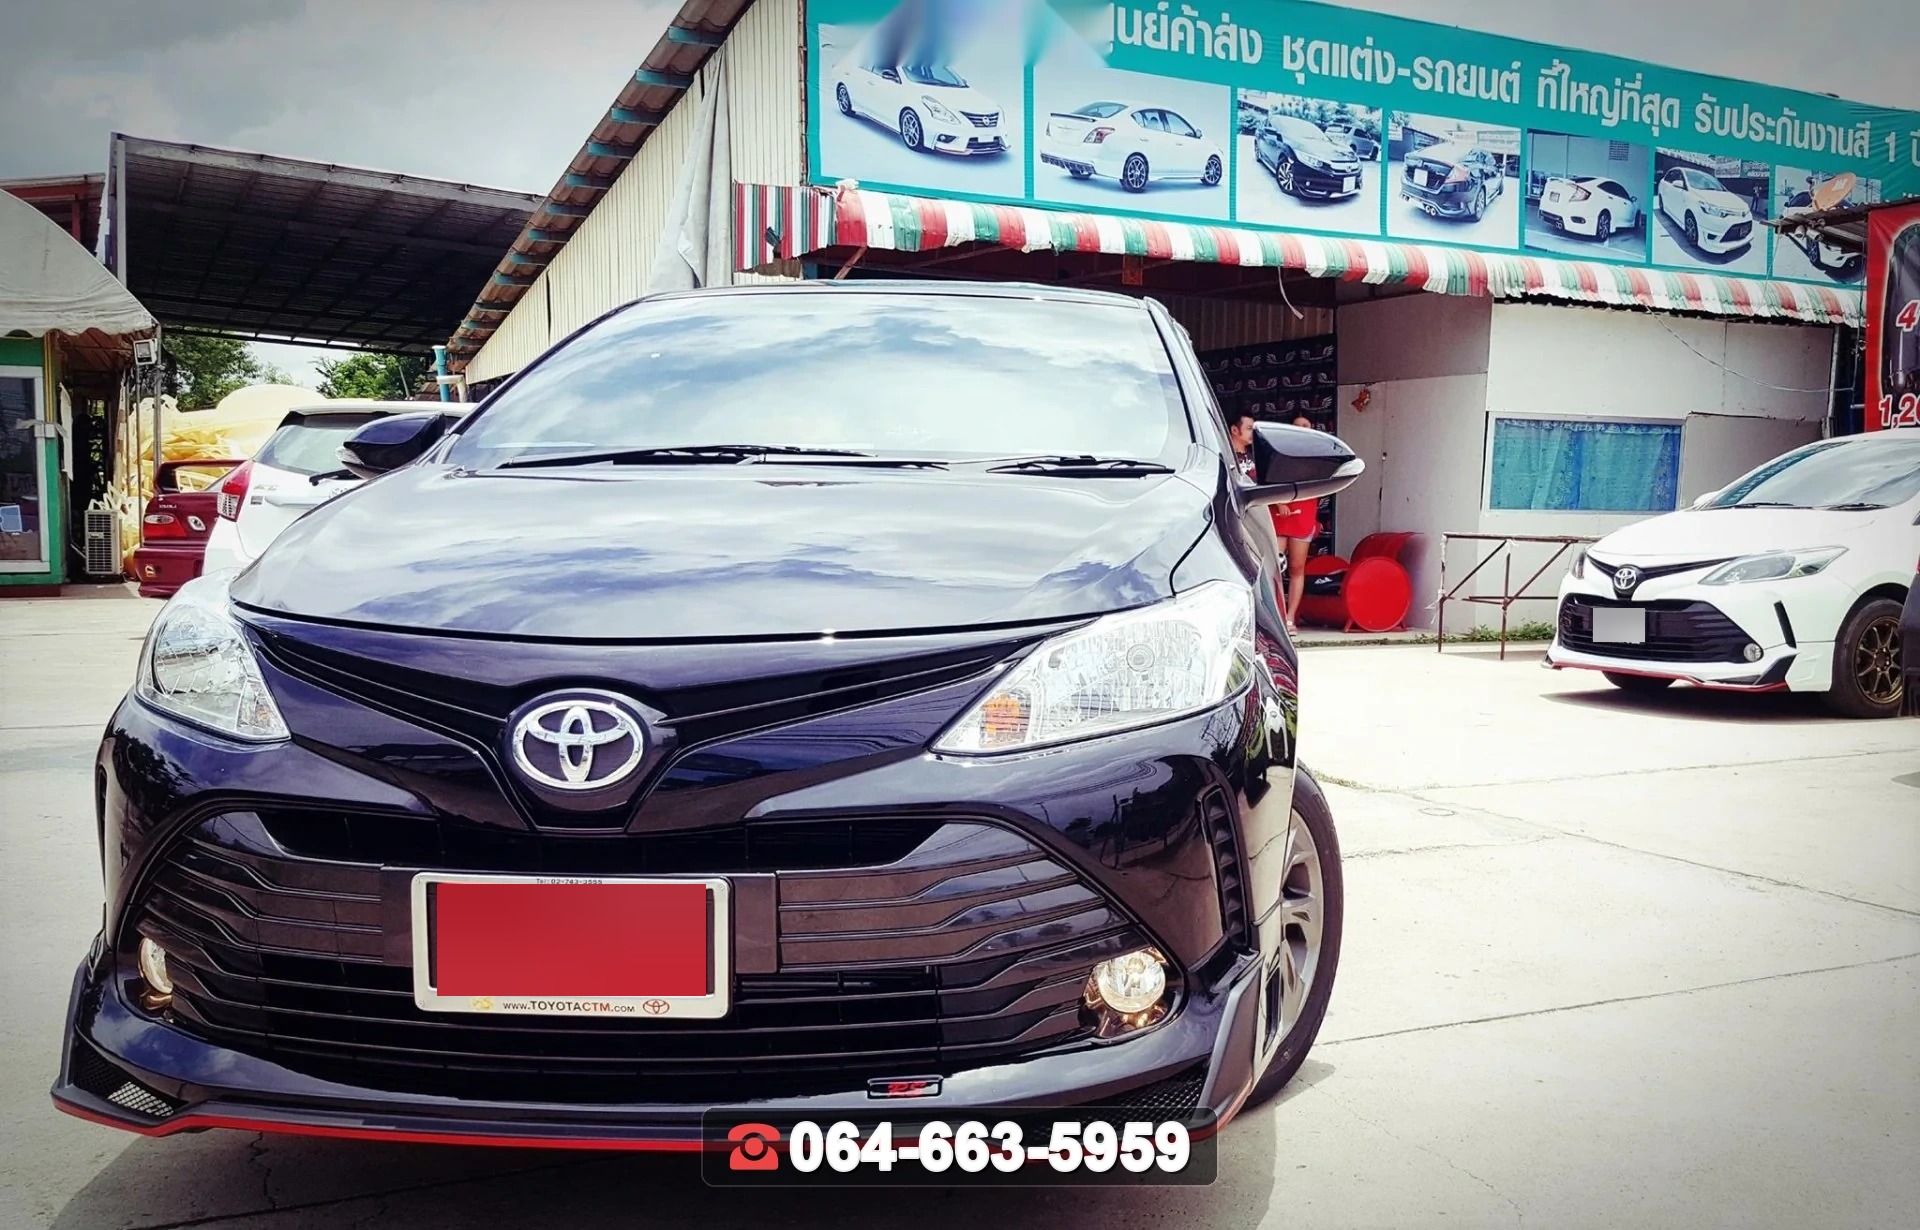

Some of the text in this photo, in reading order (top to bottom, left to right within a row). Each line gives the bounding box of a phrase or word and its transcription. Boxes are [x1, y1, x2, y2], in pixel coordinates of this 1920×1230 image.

[1106, 2, 1263, 65] นย์ค้าส่ง
[1537, 58, 1681, 138] ที่ใหญ่ที่สุด
[1694, 92, 1871, 159] รับประกันงานสี
[1884, 131, 1897, 163] 1
[1879, 394, 1920, 429] 1,2
